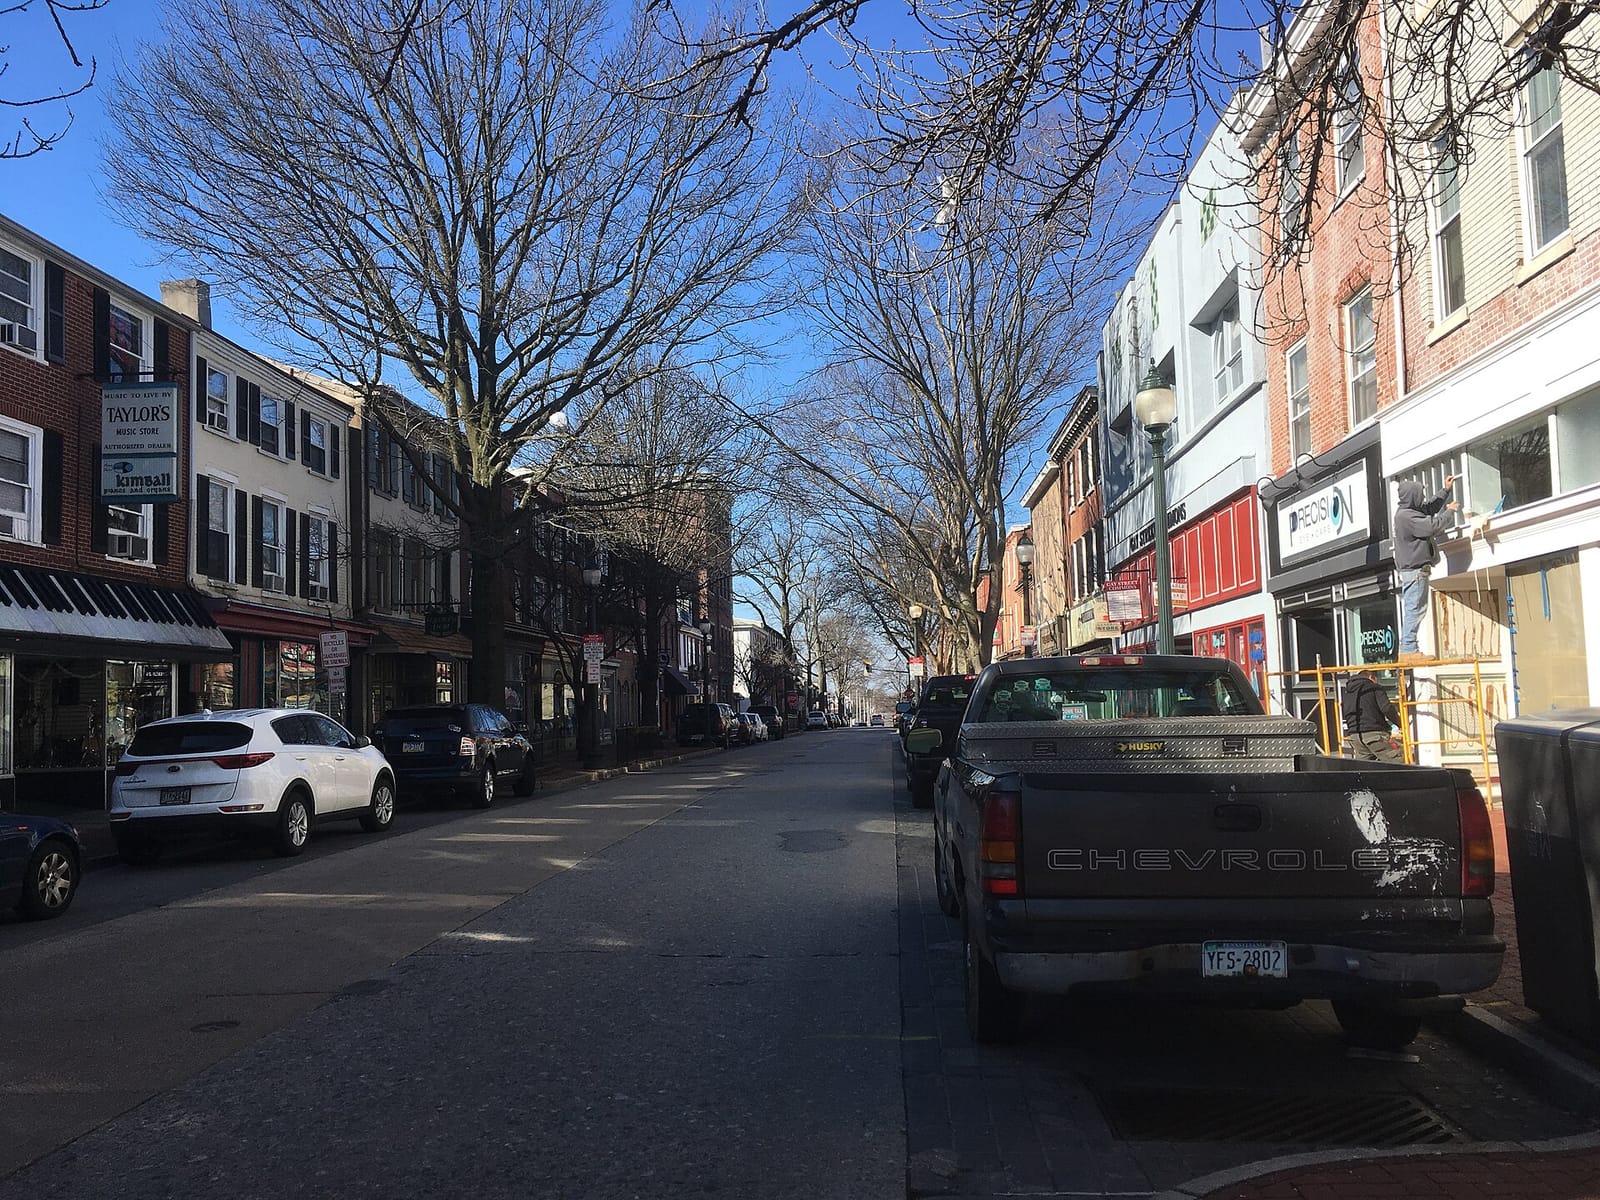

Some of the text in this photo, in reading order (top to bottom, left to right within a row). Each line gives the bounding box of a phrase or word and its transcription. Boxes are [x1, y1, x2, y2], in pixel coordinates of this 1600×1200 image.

[106, 404, 170, 423] TAYLOR'S
[116, 427, 160, 436] MUSIC STORE
[129, 486, 143, 494] and
[146, 486, 171, 494] organs
[1288, 484, 1354, 548] PRECISION
[1128, 741, 1164, 752] HUSKY
[1207, 950, 1282, 971] YFS-2802
